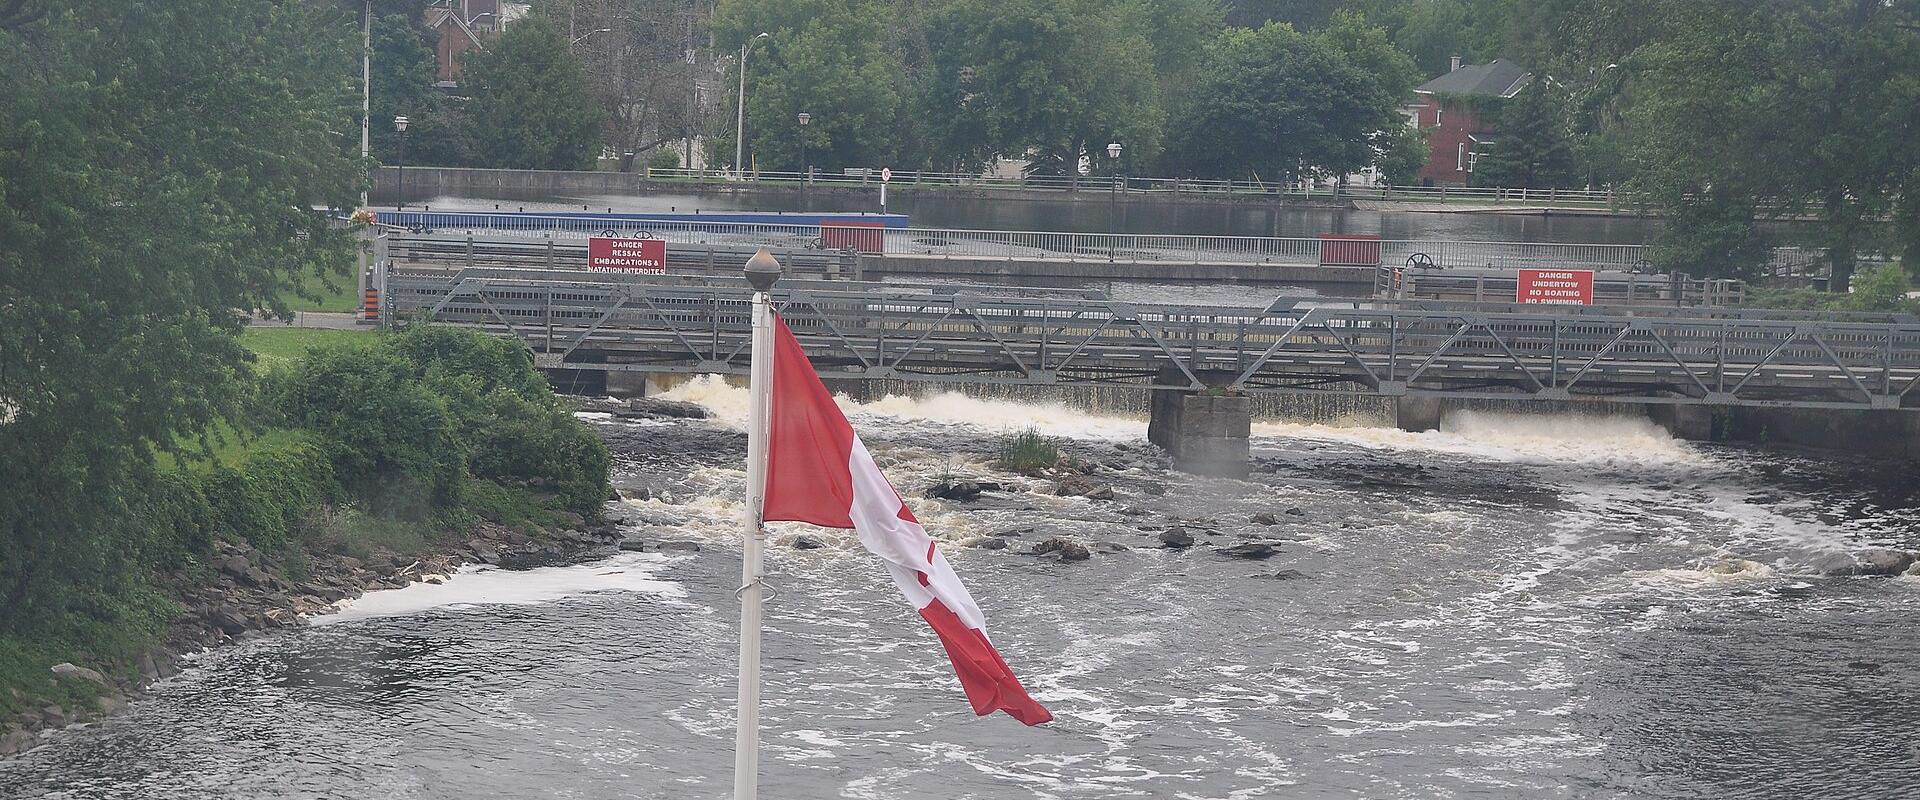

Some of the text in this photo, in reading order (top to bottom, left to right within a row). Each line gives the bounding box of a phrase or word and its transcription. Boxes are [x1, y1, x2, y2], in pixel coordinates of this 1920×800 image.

[612, 241, 643, 249] DANGER
[594, 257, 652, 266] EMBARCATIONS
[589, 266, 665, 275] NATATION INTERDITES
[1532, 280, 1578, 288] UNDERTOW
